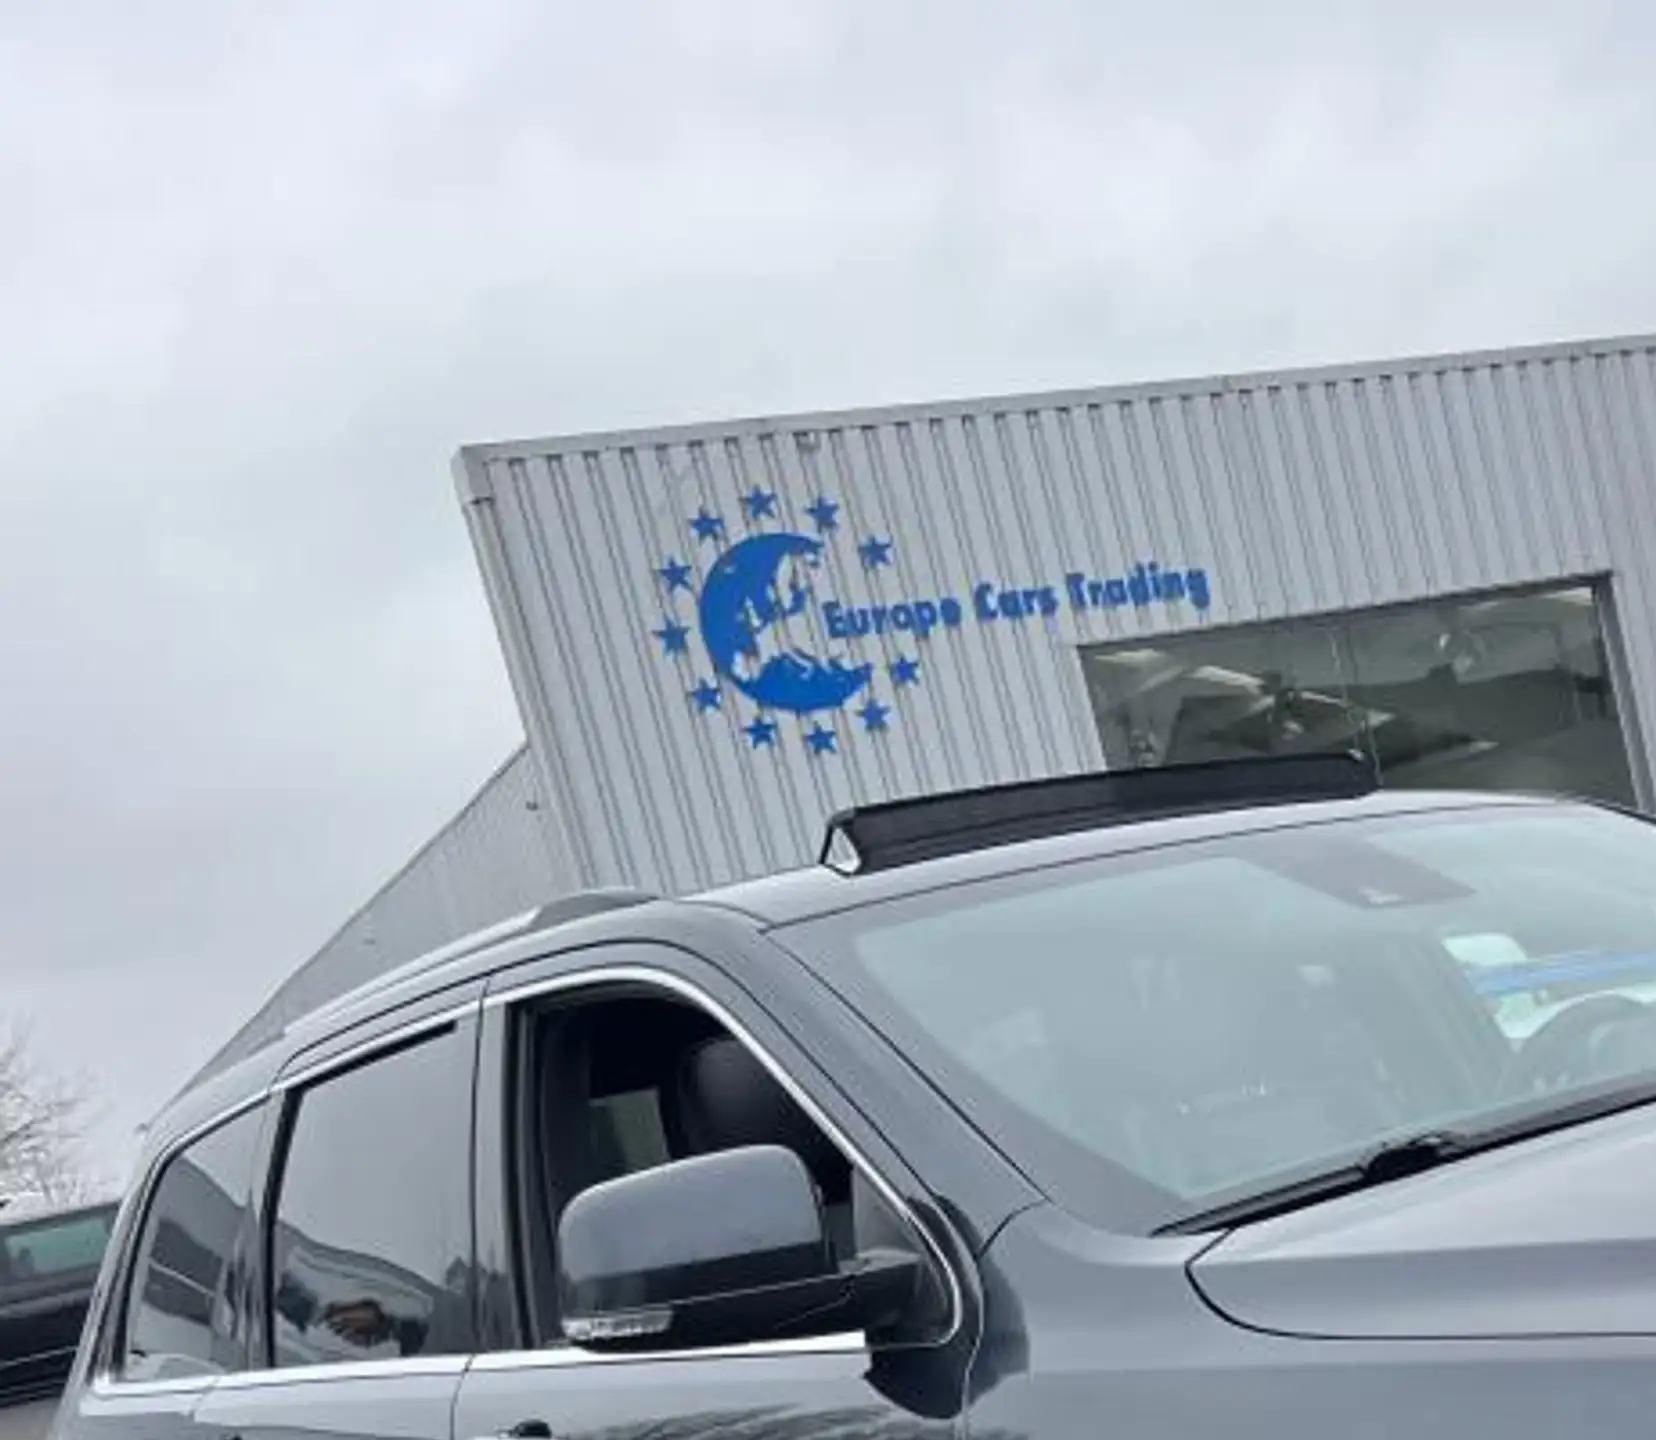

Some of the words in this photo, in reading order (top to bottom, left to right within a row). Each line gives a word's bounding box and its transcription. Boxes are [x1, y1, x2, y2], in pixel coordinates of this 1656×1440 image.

[823, 596, 962, 638] Europe
[974, 581, 1058, 621] Cars
[1066, 561, 1210, 610] Trading
